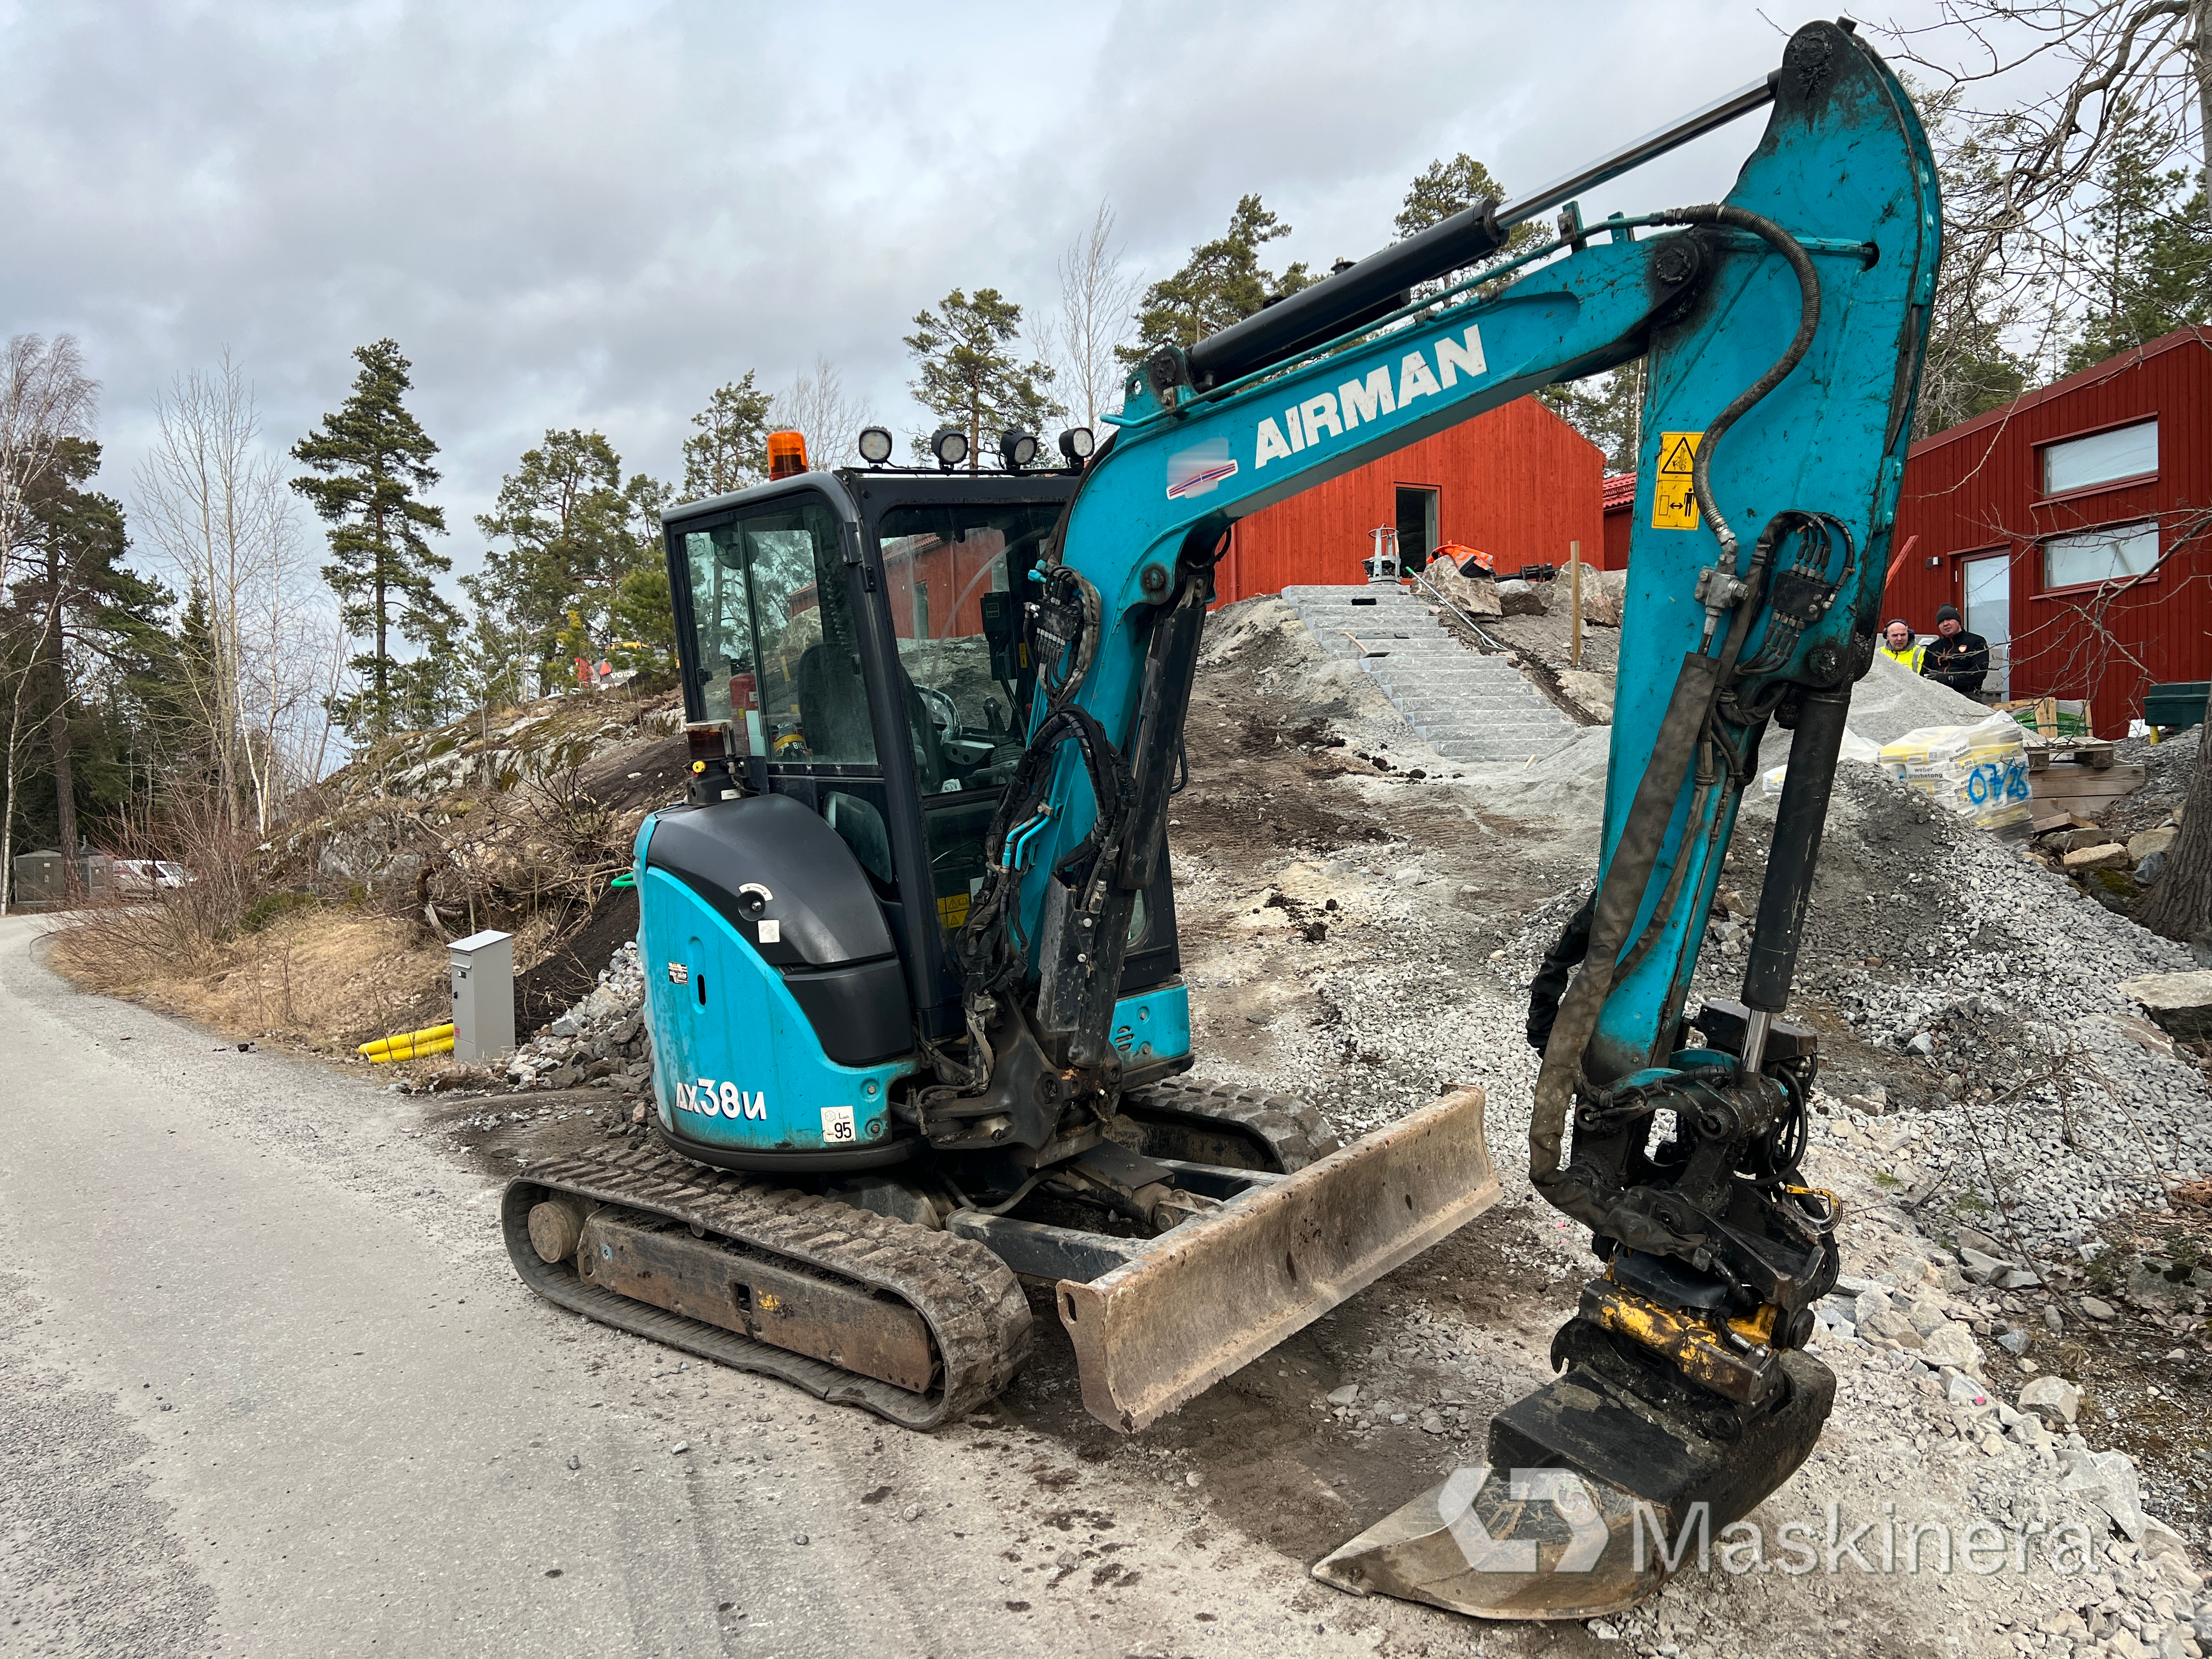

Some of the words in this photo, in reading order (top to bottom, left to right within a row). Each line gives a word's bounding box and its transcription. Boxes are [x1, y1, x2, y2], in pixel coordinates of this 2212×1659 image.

[1256, 324, 1487, 470] AIRMAN
[610, 670, 639, 679] VOLV
[834, 1121, 852, 1139] 95
